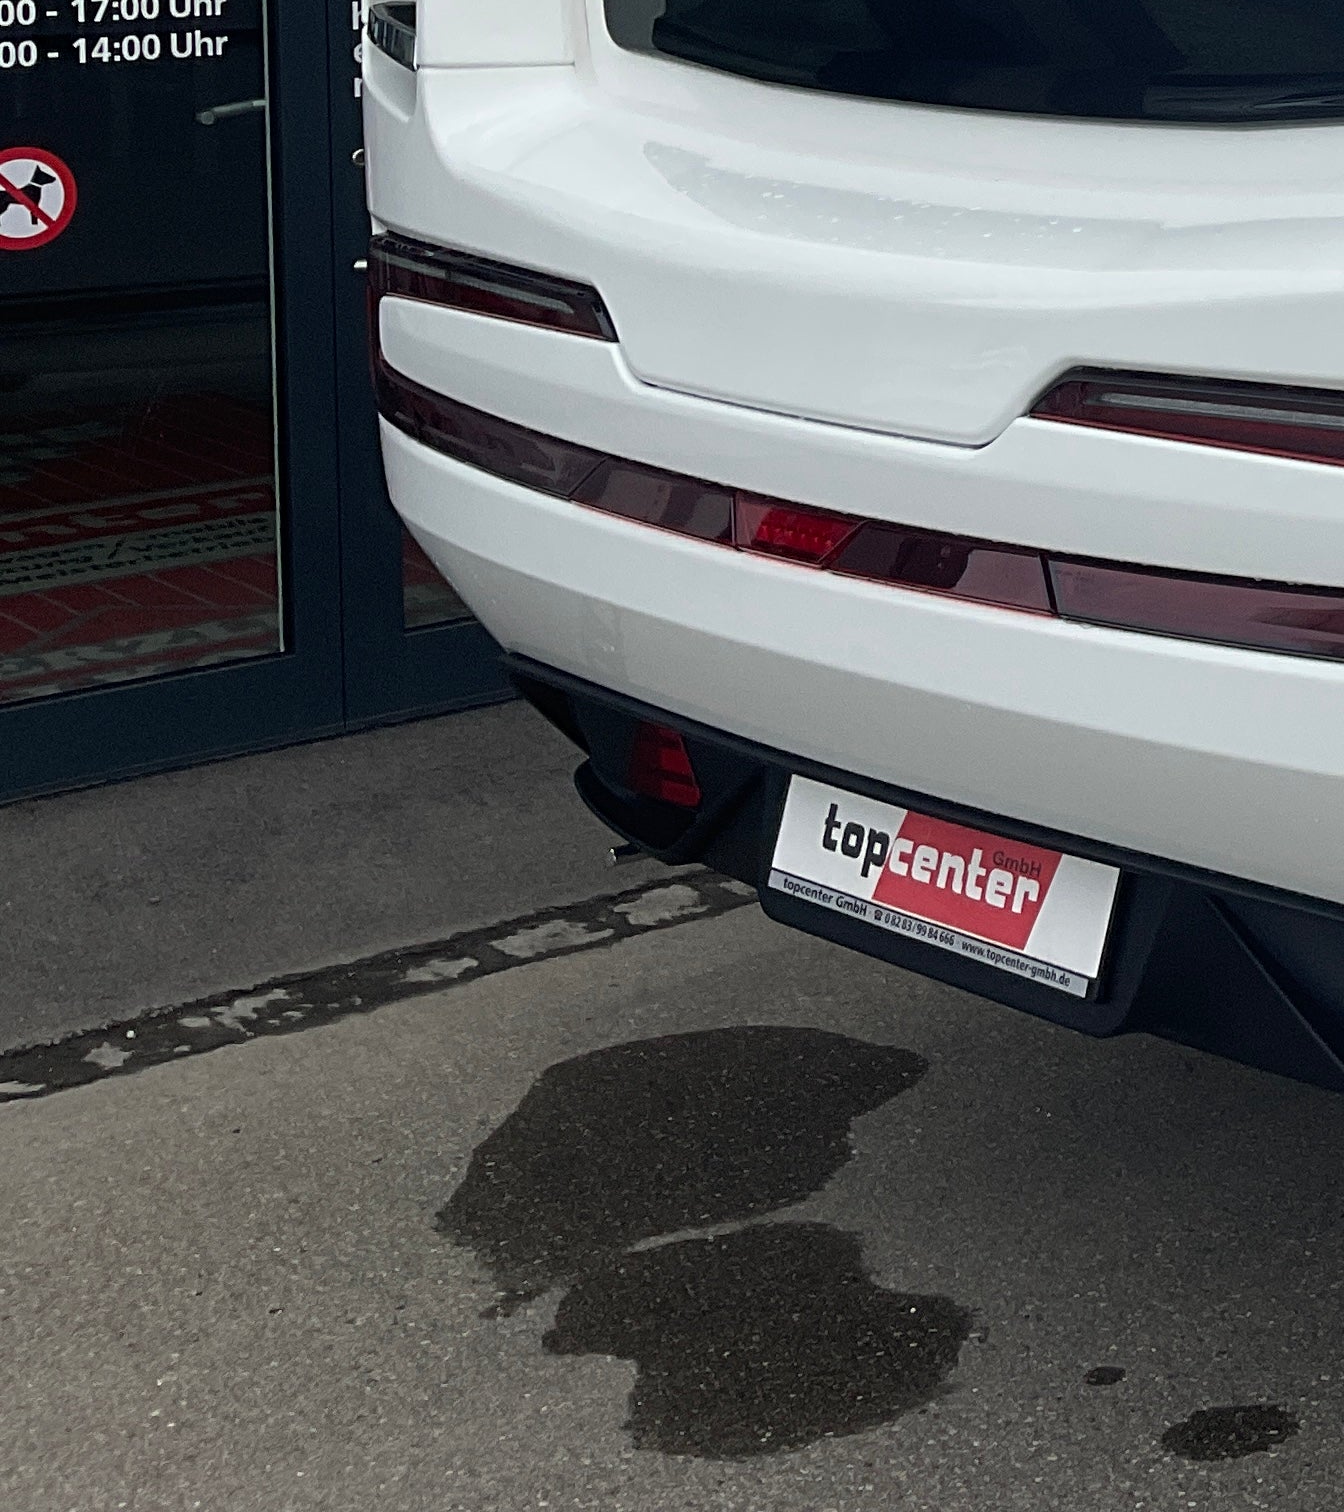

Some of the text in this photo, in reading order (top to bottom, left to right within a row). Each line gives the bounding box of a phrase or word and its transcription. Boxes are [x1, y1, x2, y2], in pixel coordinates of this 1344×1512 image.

[72, 34, 161, 64] 14:00
[170, 30, 229, 59] Uhr
[821, 803, 1041, 915] topcenter
[992, 850, 1042, 878] GmbH
[783, 877, 834, 906] topcenter
[836, 894, 868, 918] GmbH
[961, 939, 1071, 988] www.topcenter-gmbh.de
